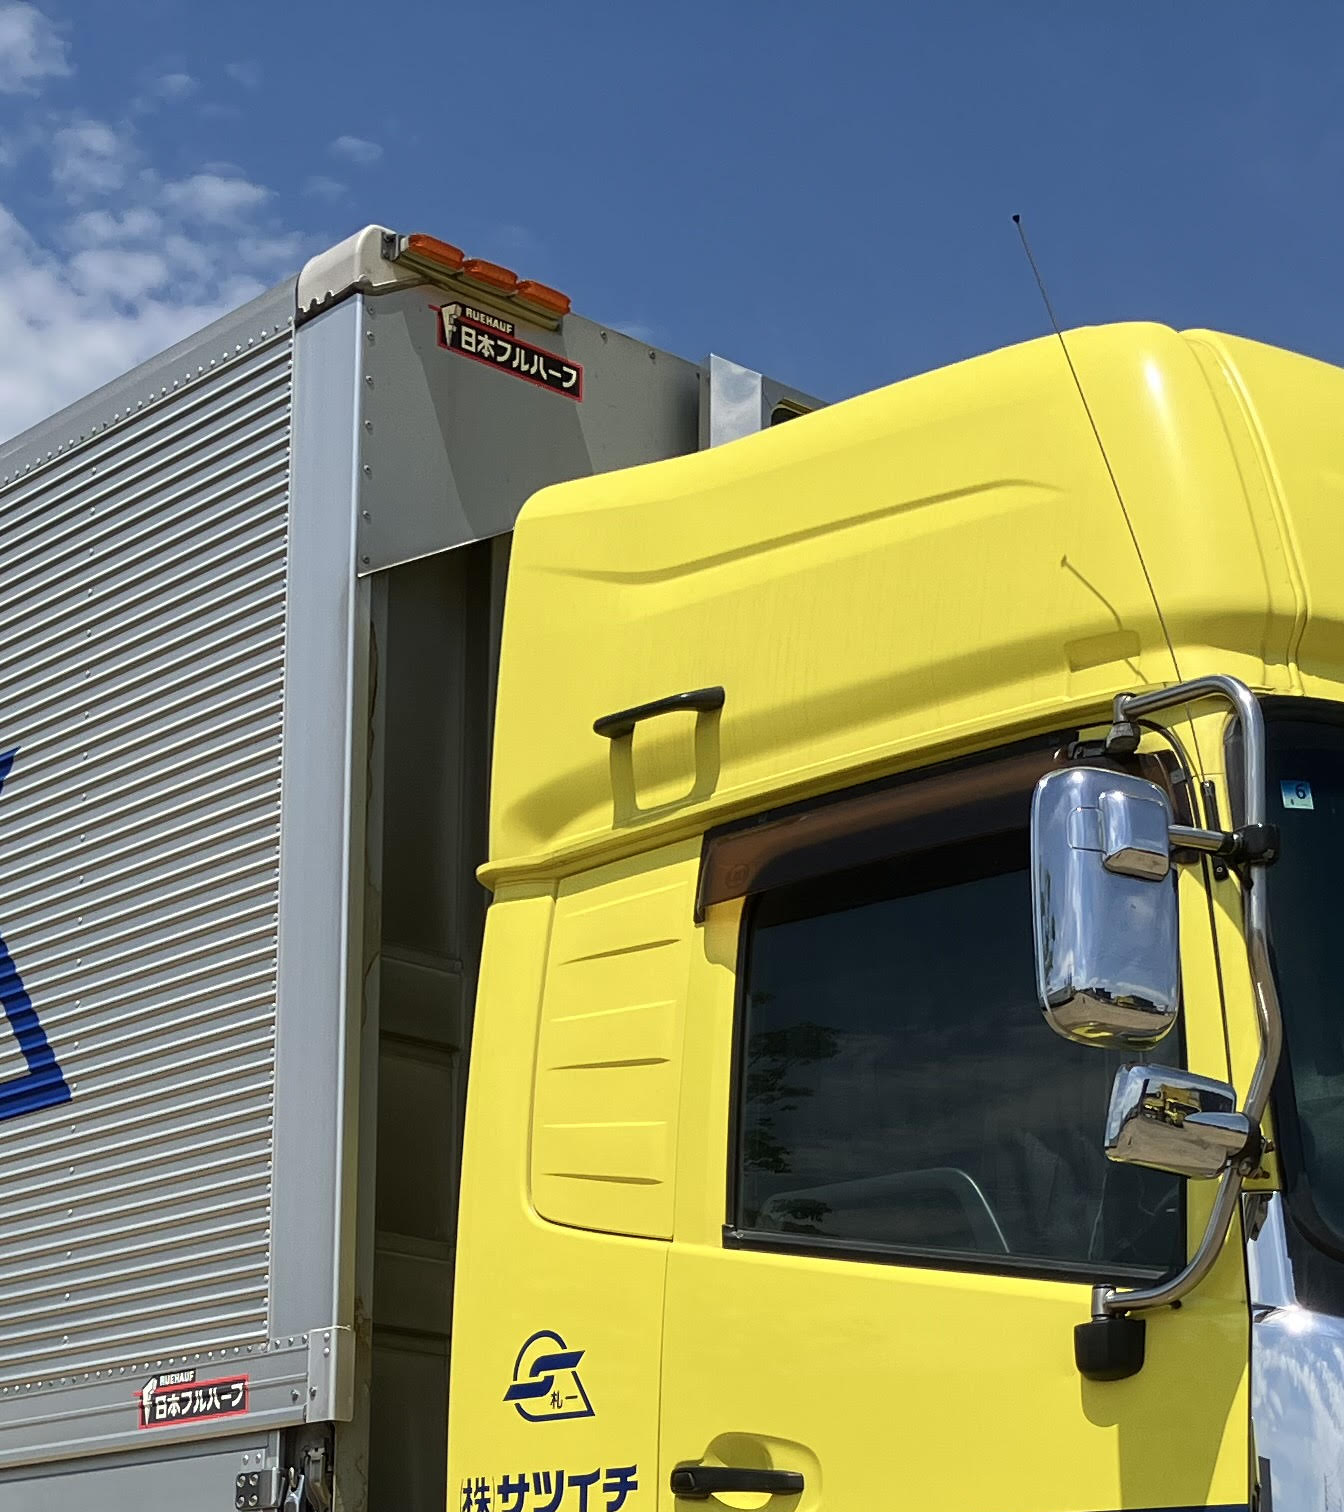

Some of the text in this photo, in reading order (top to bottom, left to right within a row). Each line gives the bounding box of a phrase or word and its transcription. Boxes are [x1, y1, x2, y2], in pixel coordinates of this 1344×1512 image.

[461, 325, 577, 388] 日本フルハーフ
[156, 1382, 244, 1420] 日本フルハーフ
[550, 1391, 578, 1409] 札一
